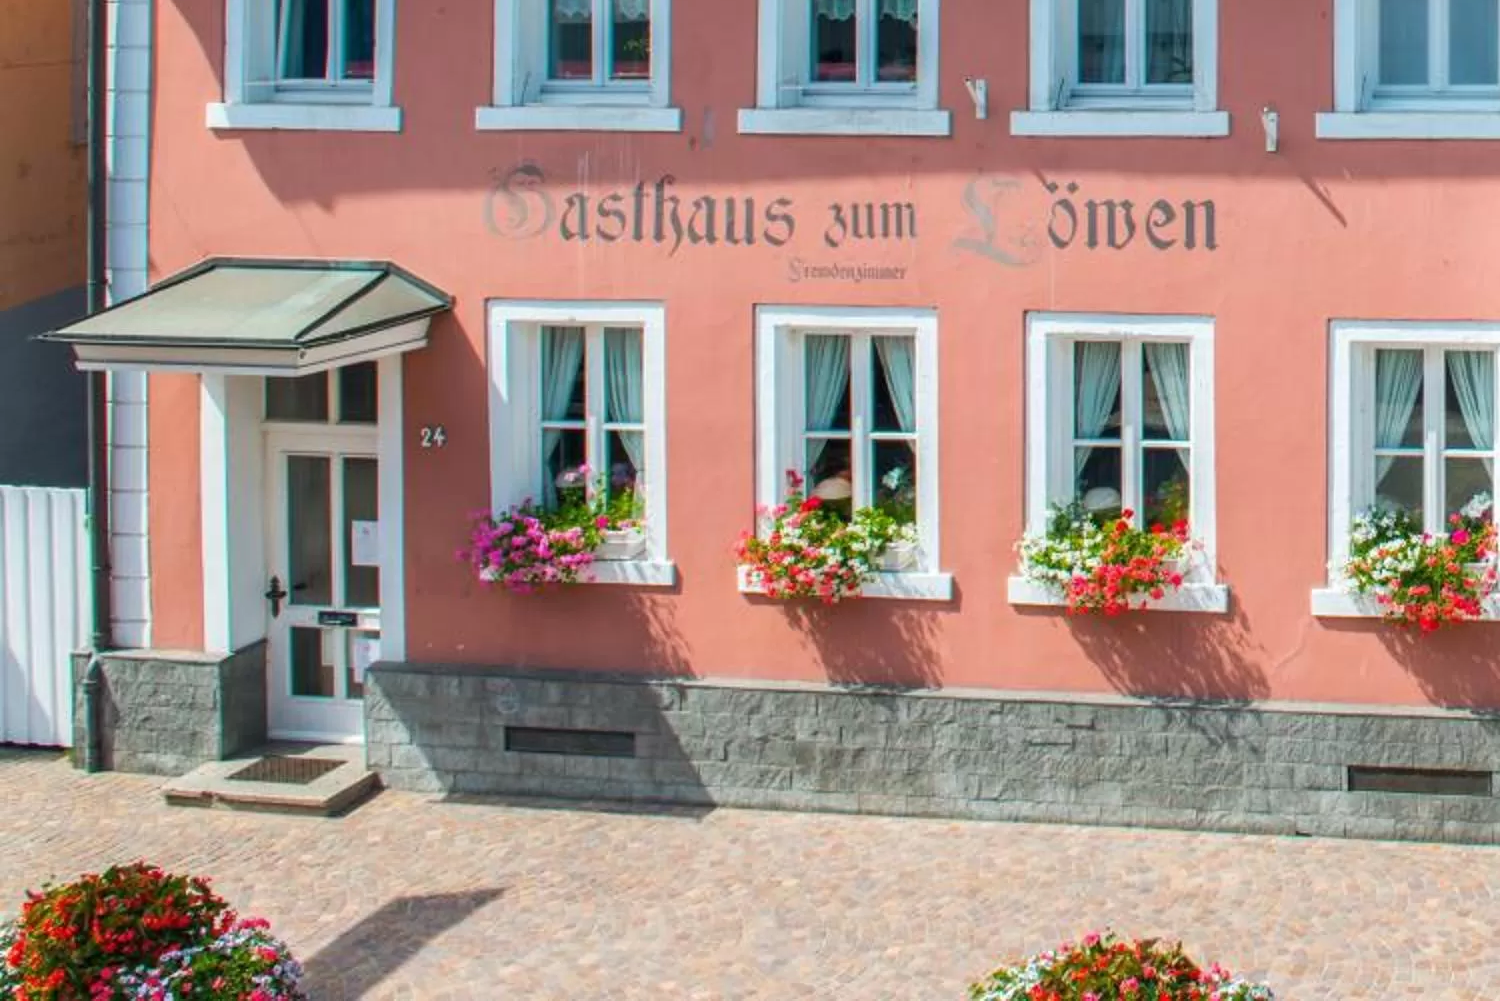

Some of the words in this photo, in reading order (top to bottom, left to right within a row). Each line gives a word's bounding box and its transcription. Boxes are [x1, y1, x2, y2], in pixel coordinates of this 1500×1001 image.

[484, 160, 797, 257] Gasthaus
[824, 201, 918, 248] zum
[951, 173, 1219, 268] Löwen
[420, 427, 446, 448] 24
